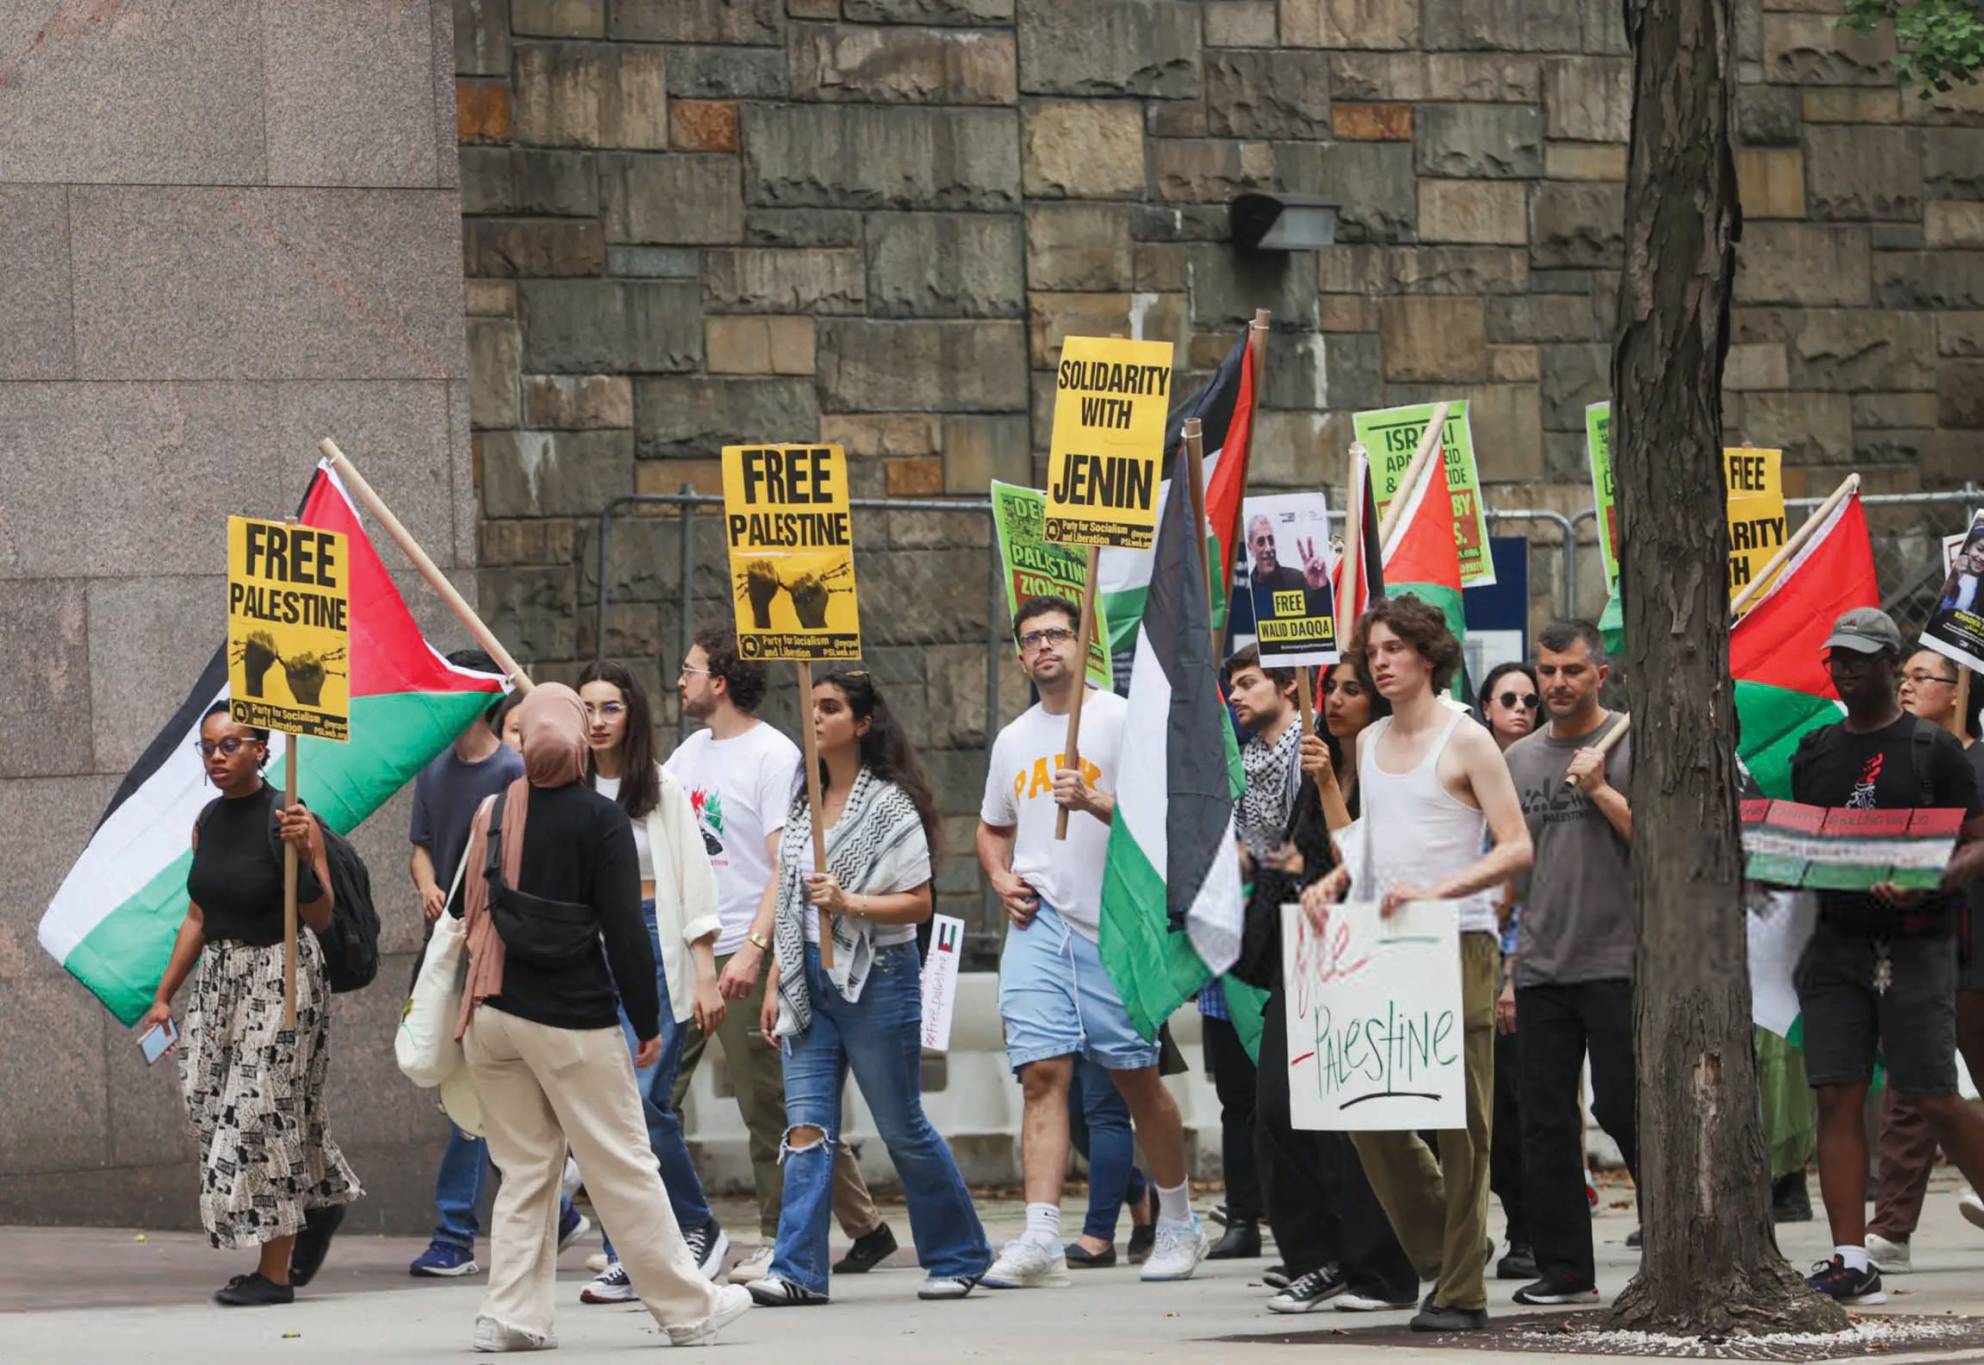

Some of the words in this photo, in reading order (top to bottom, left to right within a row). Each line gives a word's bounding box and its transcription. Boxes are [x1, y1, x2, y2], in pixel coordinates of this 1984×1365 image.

[1059, 360, 1169, 396] SOLIDARITY
[1081, 397, 1133, 429] WITH
[1385, 422, 1455, 452] ISRLI
[741, 449, 833, 504] FREE
[1053, 454, 1154, 510] JENIN
[1452, 493, 1471, 517] BY
[729, 512, 850, 547] PALESTINE
[1062, 533, 1073, 542] and
[1074, 533, 1110, 545] Liberation
[1063, 521, 1077, 534] Party
[1079, 522, 1089, 532] for
[1089, 522, 1128, 535] Socialism
[246, 523, 336, 588] FREE
[230, 582, 347, 632] PALESTINE
[1275, 594, 1304, 613] FREE
[763, 636, 781, 647] Party
[794, 635, 829, 645] Socialism
[1261, 622, 1288, 639] WALID
[1290, 619, 1331, 637] DAQQA
[764, 647, 778, 657] and
[252, 703, 270, 718] Party
[273, 706, 282, 717] for
[282, 709, 321, 723] Socialism
[253, 717, 266, 727] and
[268, 717, 303, 733] Liberation
